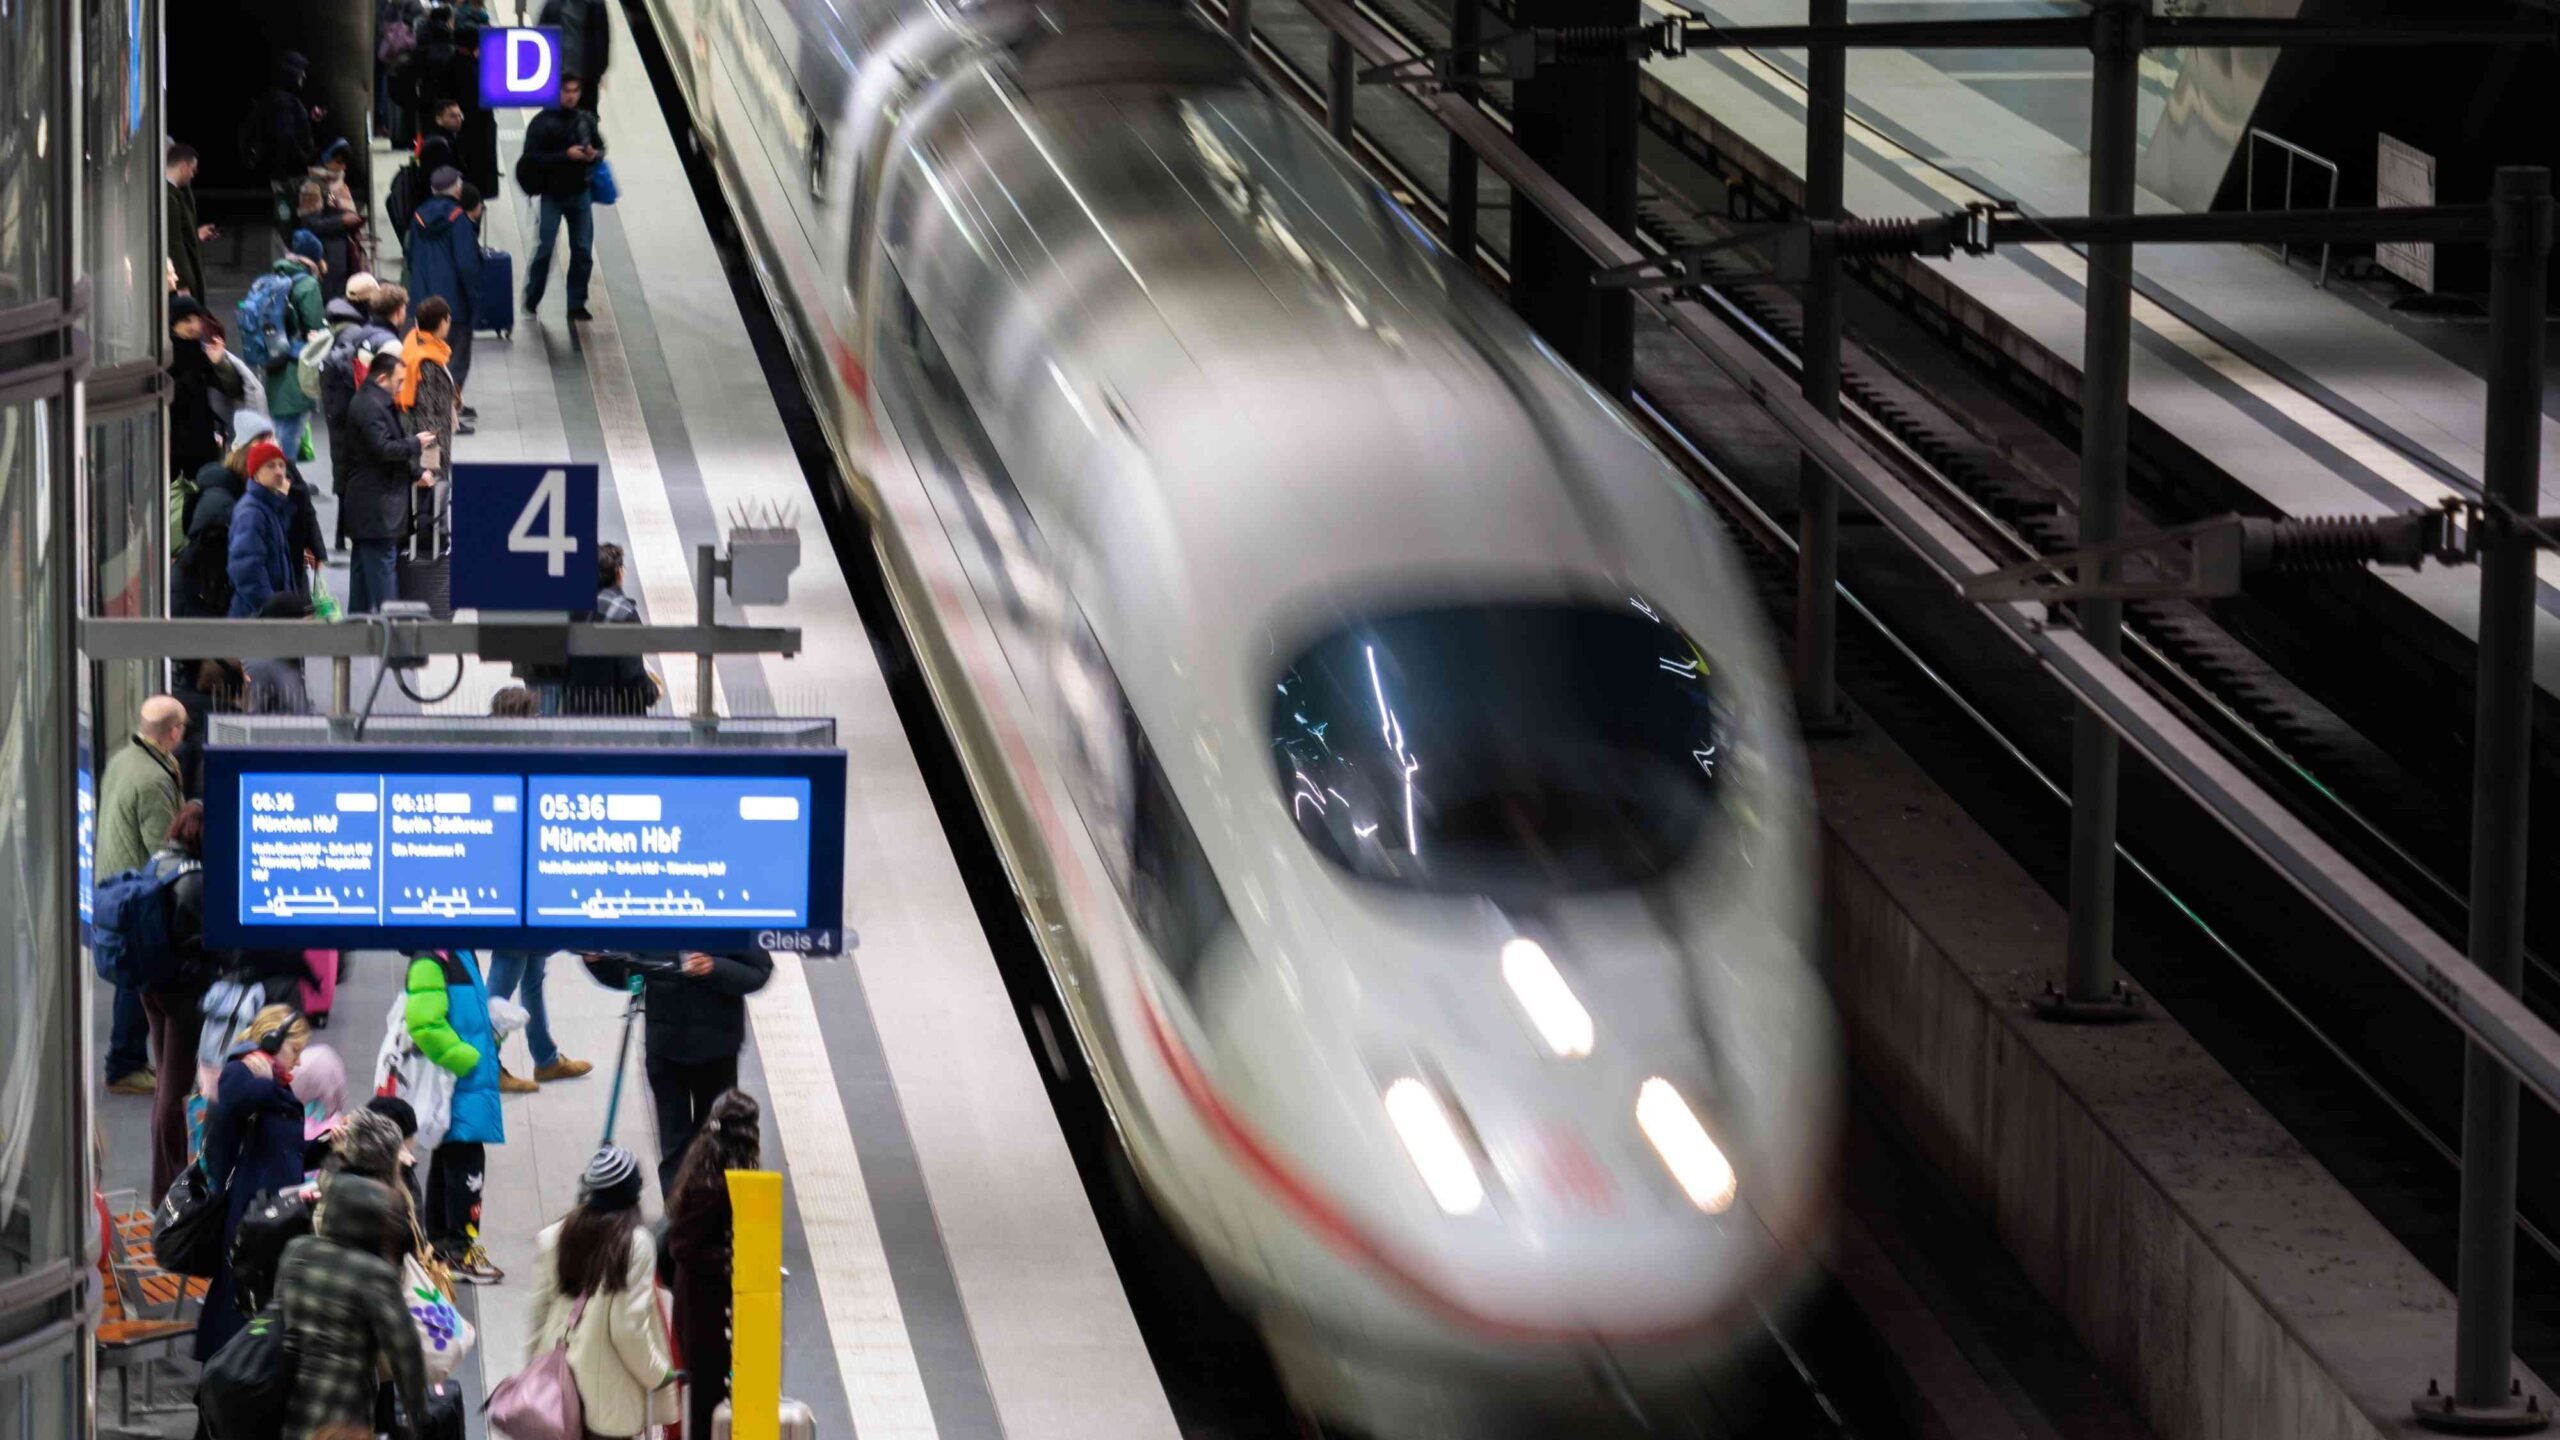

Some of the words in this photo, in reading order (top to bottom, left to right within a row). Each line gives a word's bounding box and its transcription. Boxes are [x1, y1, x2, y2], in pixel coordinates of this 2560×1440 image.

[505, 29, 552, 92] D
[508, 470, 578, 576] 4
[540, 794, 605, 820] 05:36
[540, 825, 637, 853] München
[642, 826, 682, 853] Hbf
[758, 930, 812, 950] Gleis
[818, 931, 831, 950] 4
